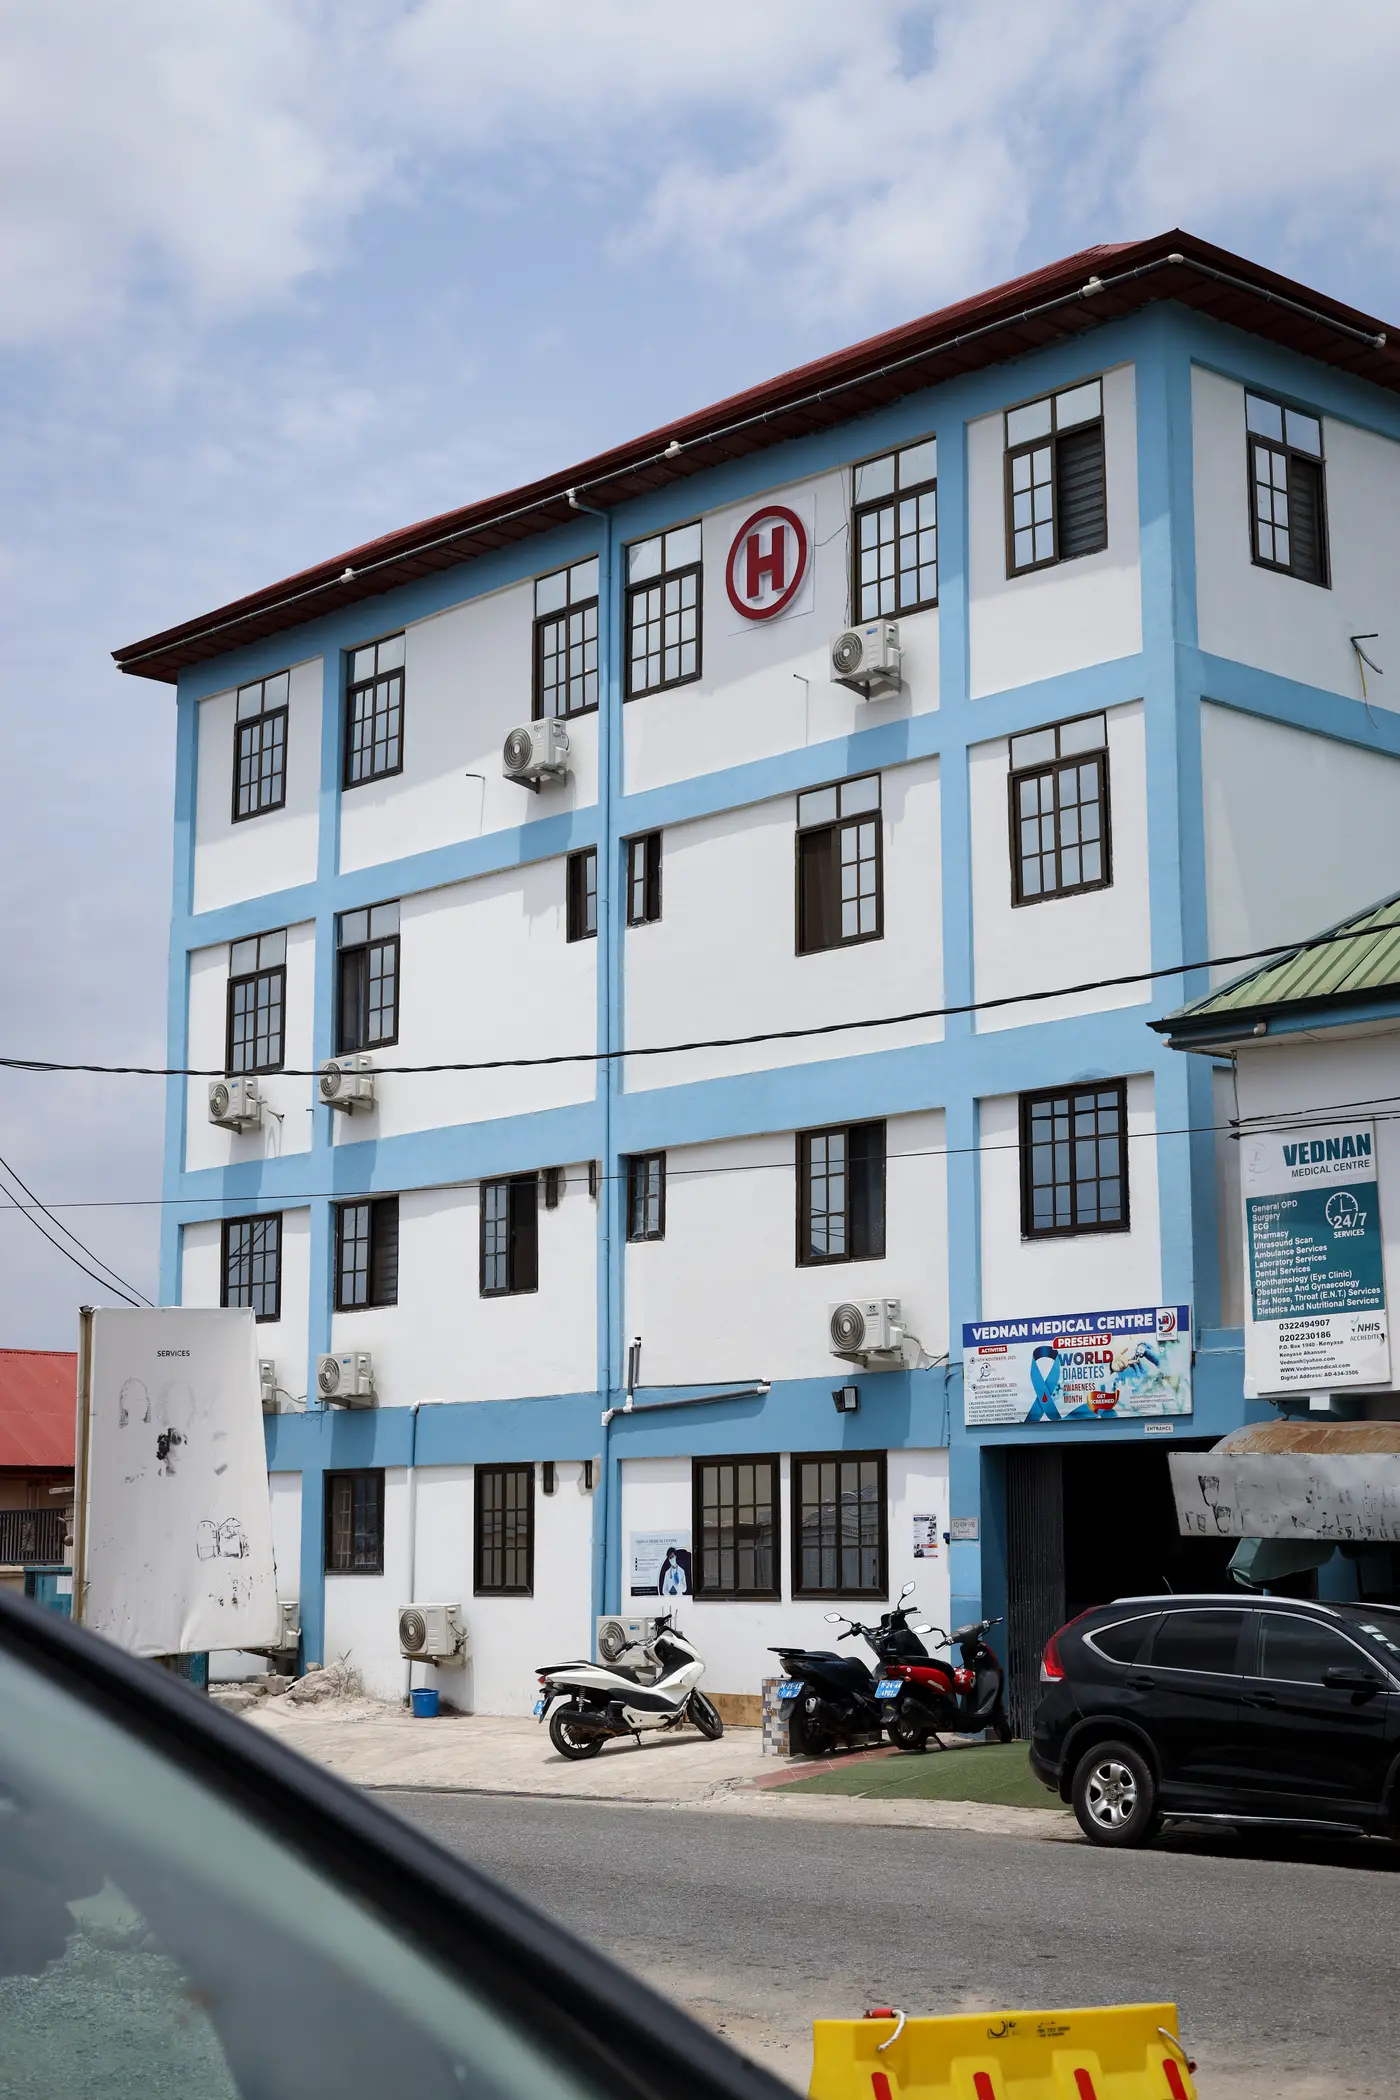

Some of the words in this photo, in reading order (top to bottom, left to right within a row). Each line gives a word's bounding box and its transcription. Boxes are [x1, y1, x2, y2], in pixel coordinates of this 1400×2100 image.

[747, 525, 786, 599] H
[1282, 1133, 1371, 1166] VEDNAN
[1291, 1164, 1331, 1178] MEDICAL
[1333, 1159, 1370, 1172] CENTRE
[1252, 1202, 1280, 1212] General
[1281, 1200, 1298, 1208] OPD
[1252, 1213, 1280, 1222] Surgery
[1333, 1212, 1367, 1229] 24/7
[1253, 1222, 1269, 1230] ECG
[1253, 1230, 1289, 1240] Pharmacy
[1333, 1229, 1364, 1239] SERVICES
[1254, 1238, 1293, 1250] Ultrasound
[1254, 1248, 1294, 1258] Ambulance
[1296, 1244, 1328, 1254] Services
[1254, 1258, 1294, 1268] Laboratory
[1296, 1254, 1326, 1264] Services
[1256, 1268, 1278, 1278] Dental
[1280, 1266, 1310, 1274] Services
[1256, 1276, 1308, 1287] Ophthamology
[1310, 1272, 1326, 1282] (Eye
[1328, 1270, 1352, 1278] Clinic)
[1256, 1286, 1293, 1296] Obstetrics
[1294, 1284, 1310, 1292] And
[1312, 1280, 1360, 1291] Gynaecology
[1294, 1292, 1318, 1301] Throat
[1320, 1290, 1346, 1300] (E.N.T.)
[1348, 1287, 1380, 1296] Services
[1257, 1305, 1288, 1314] Dietetics
[1290, 1303, 1304, 1312] And
[1306, 1299, 1344, 1310] Nutritional
[1346, 1297, 1379, 1306] Services
[972, 1324, 1028, 1340] VEDNAN
[1032, 1319, 1094, 1336] MEDICAL
[1097, 1314, 1153, 1330] CENTRE
[1279, 1319, 1330, 1330] 0322494907
[1358, 1322, 1380, 1332] NHIS
[1058, 1335, 1108, 1348] PRESENTS
[1280, 1331, 1331, 1342] 0202230186
[1350, 1334, 1382, 1342] ACCREDITE
[1058, 1350, 1113, 1366] WORLD
[1062, 1366, 1104, 1380] DIABETES
[1063, 1382, 1096, 1392] AWARENESS
[1064, 1395, 1082, 1404] MONTH
